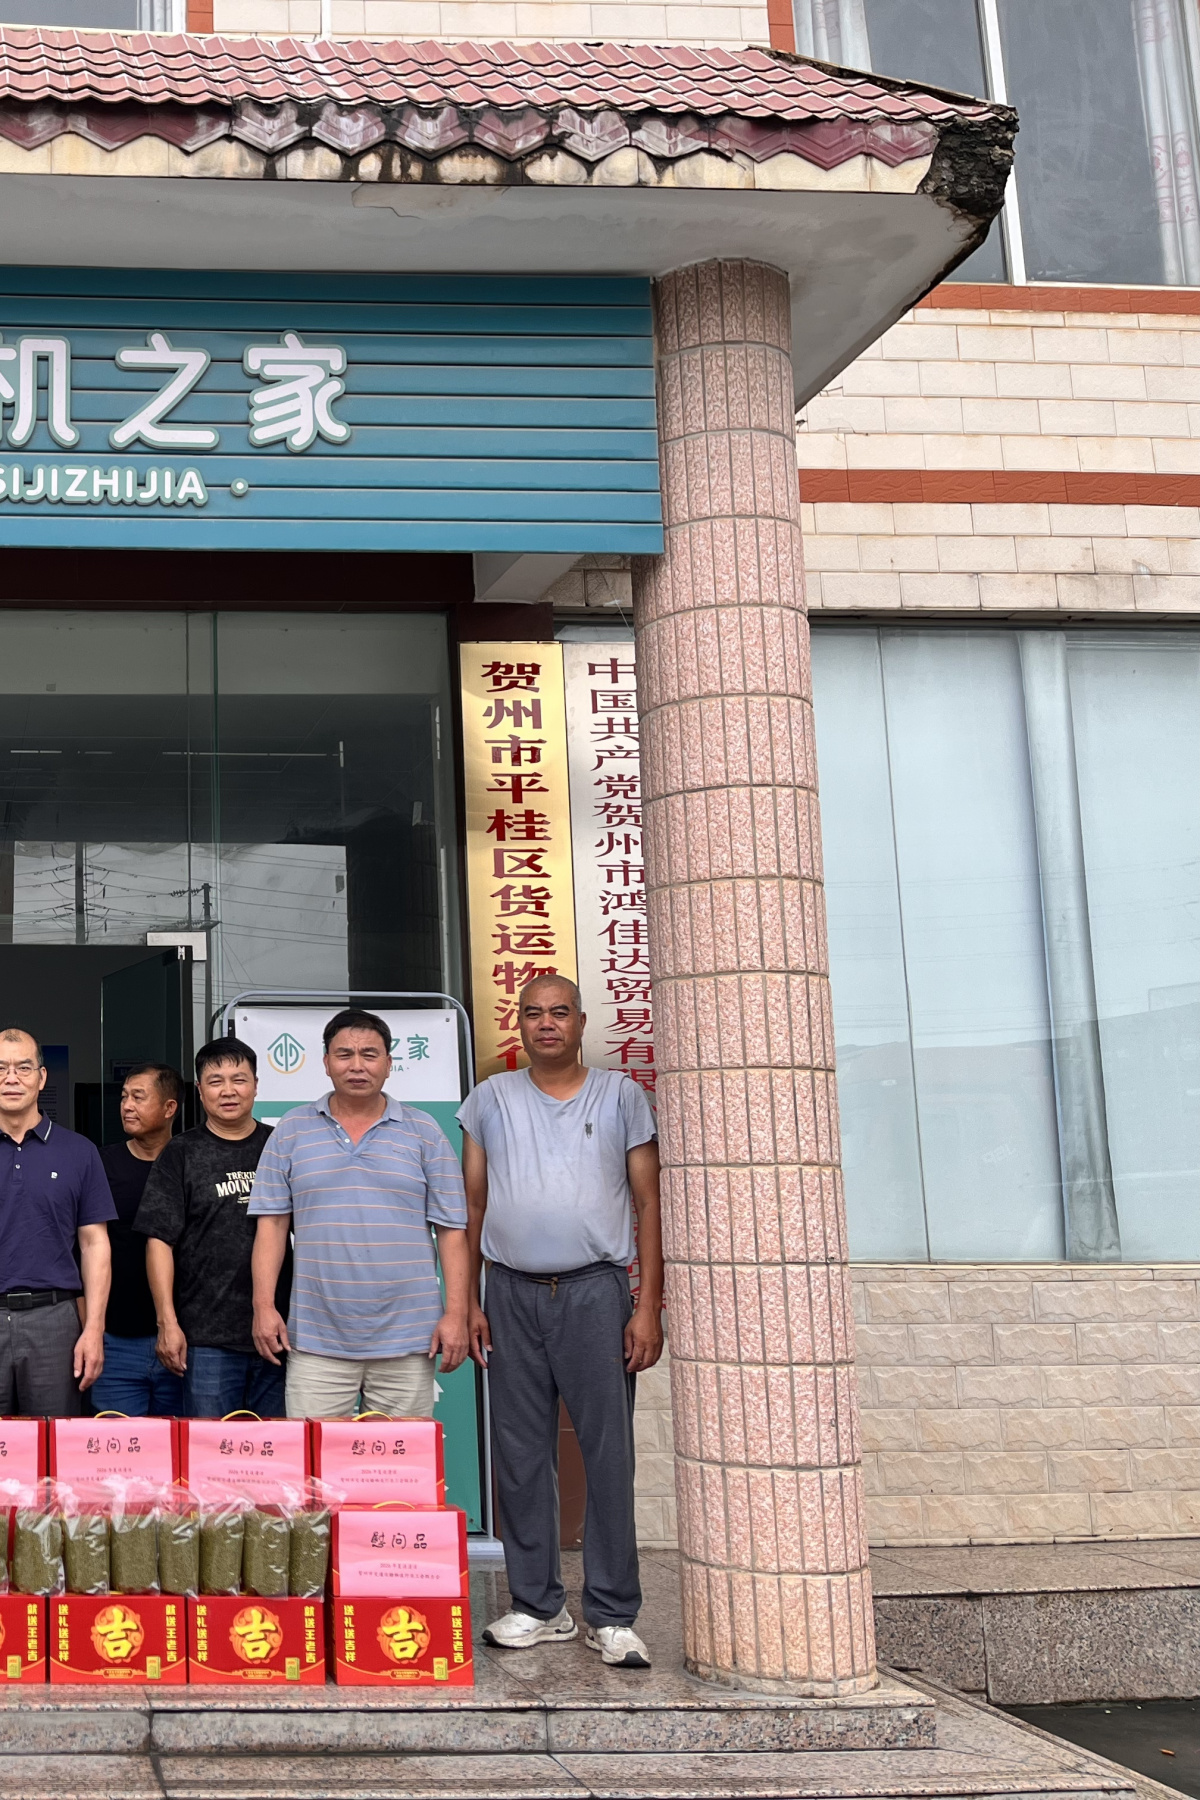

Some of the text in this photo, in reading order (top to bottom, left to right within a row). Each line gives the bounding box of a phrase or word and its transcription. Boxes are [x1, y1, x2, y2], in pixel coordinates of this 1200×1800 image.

[86, 1437, 141, 1454] 慰问品
[219, 1439, 274, 1456] 慰问品
[351, 1439, 406, 1456] 慰问品
[370, 1531, 428, 1550] 慰问品
[27, 1603, 38, 1661] 就送王老吉
[58, 1604, 69, 1662] 送礼送吉祥
[96, 1607, 138, 1659] 吉
[165, 1604, 177, 1662] 就送王老吉
[196, 1605, 208, 1663] 送礼送吉祥
[234, 1609, 277, 1660] 吉
[304, 1605, 316, 1663] 就送王老吉
[343, 1604, 356, 1663] 送礼送吉祥
[382, 1608, 425, 1660] 吉
[451, 1605, 464, 1663] 就送王老吉
